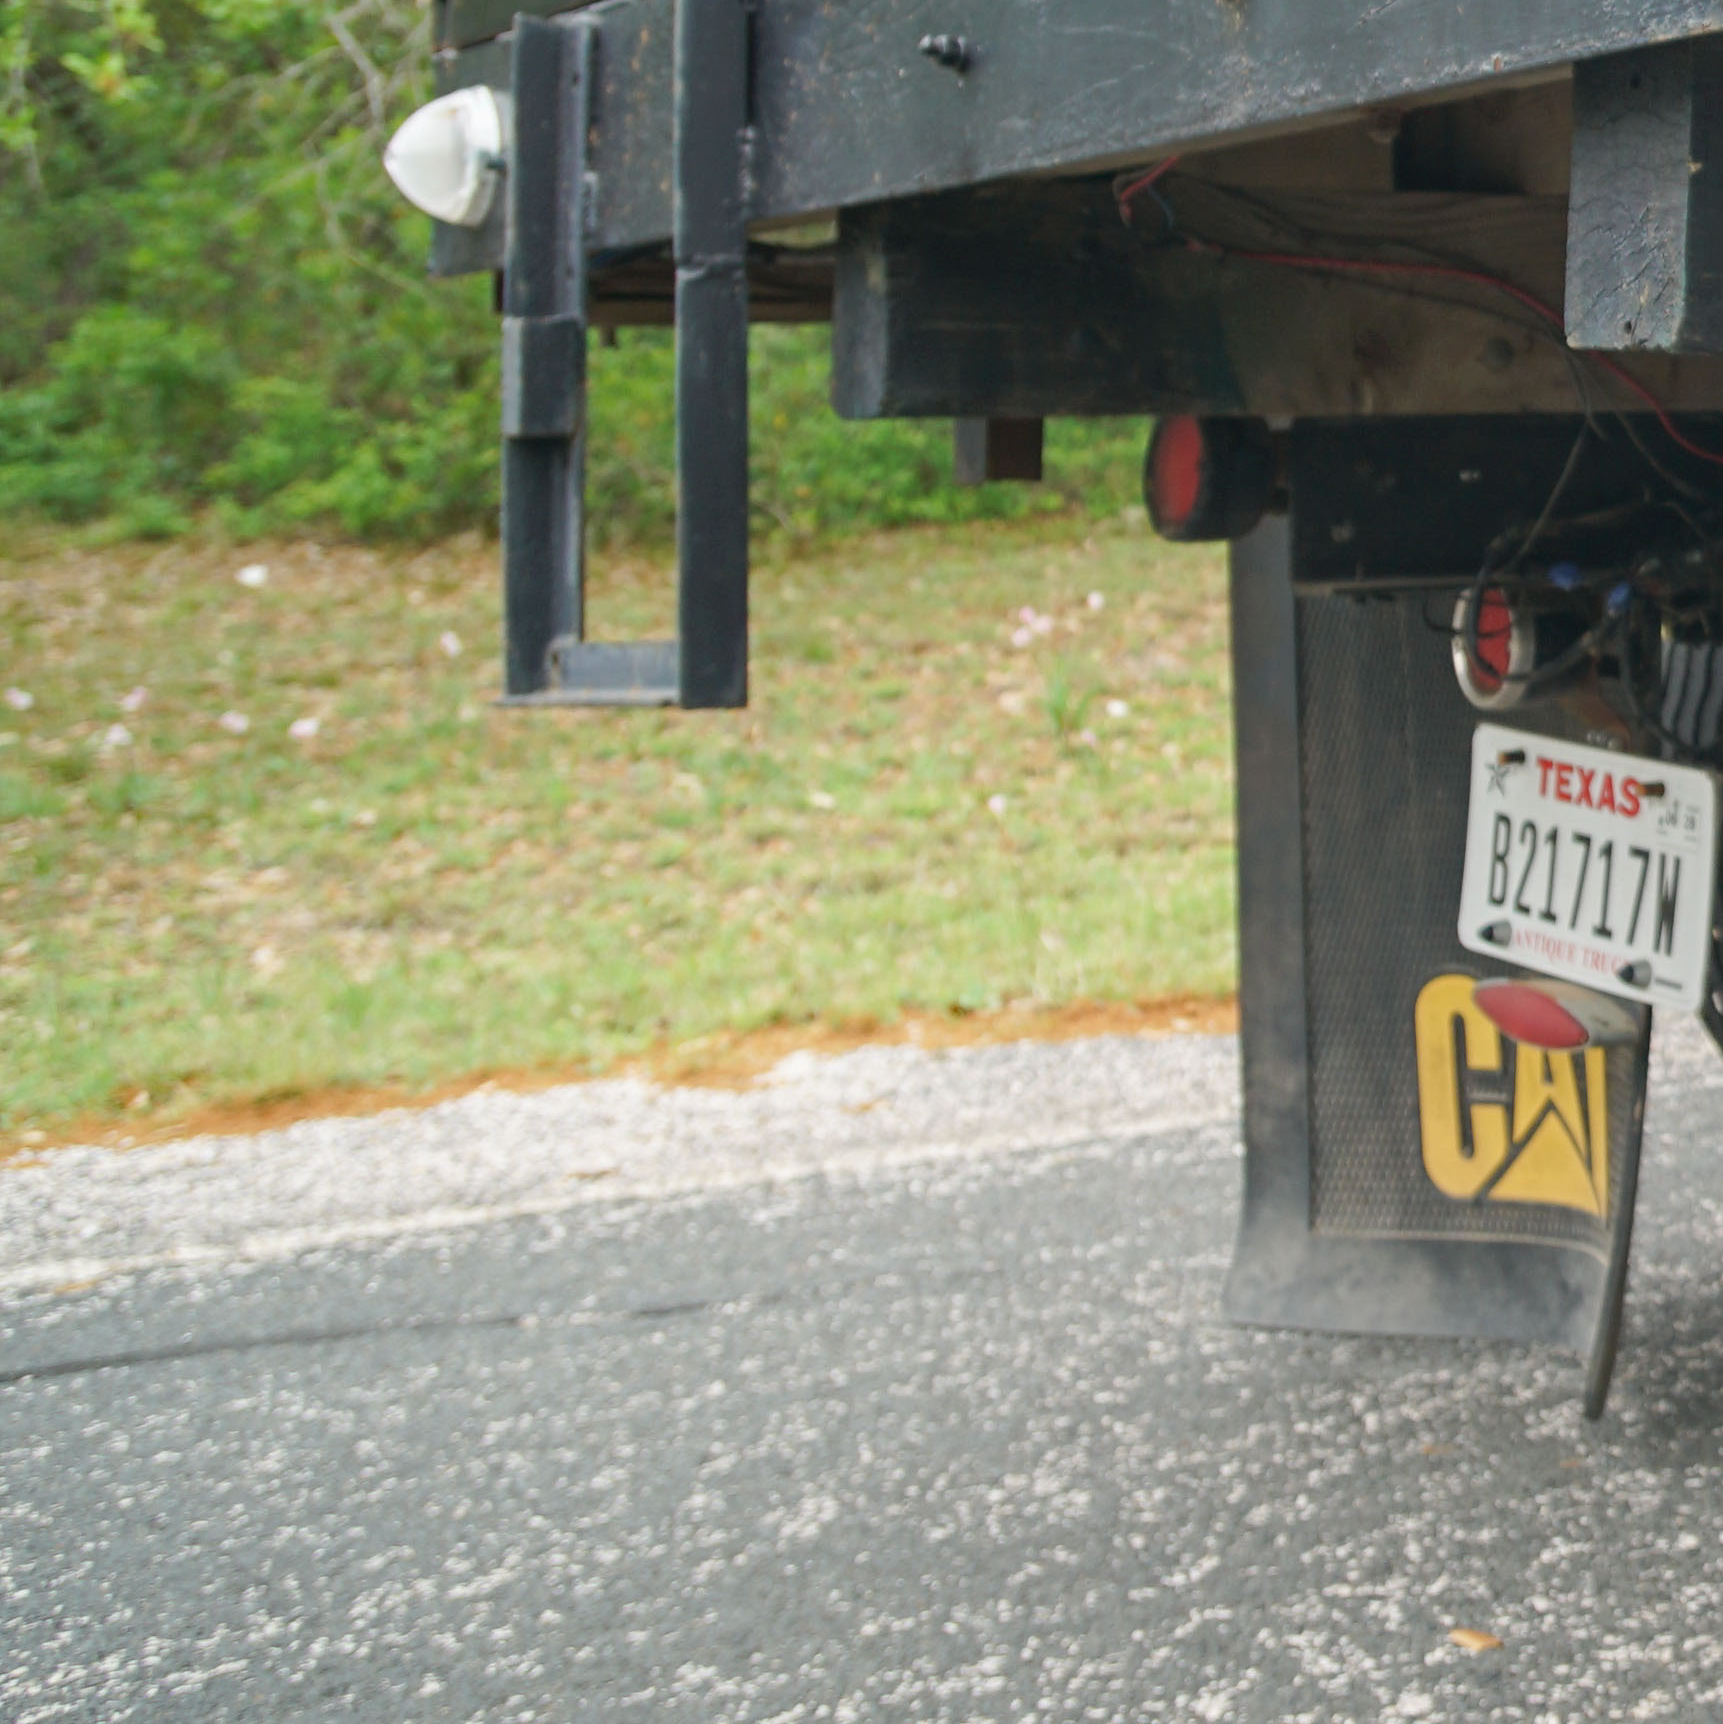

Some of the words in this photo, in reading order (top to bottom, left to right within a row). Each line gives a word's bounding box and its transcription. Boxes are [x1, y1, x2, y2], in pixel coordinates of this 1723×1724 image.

[1536, 757, 1642, 818] TEXAS
[1487, 812, 1681, 958] B21717W
[1512, 927, 1576, 964] ANTIQUE
[1582, 945, 1628, 975] TRUC
